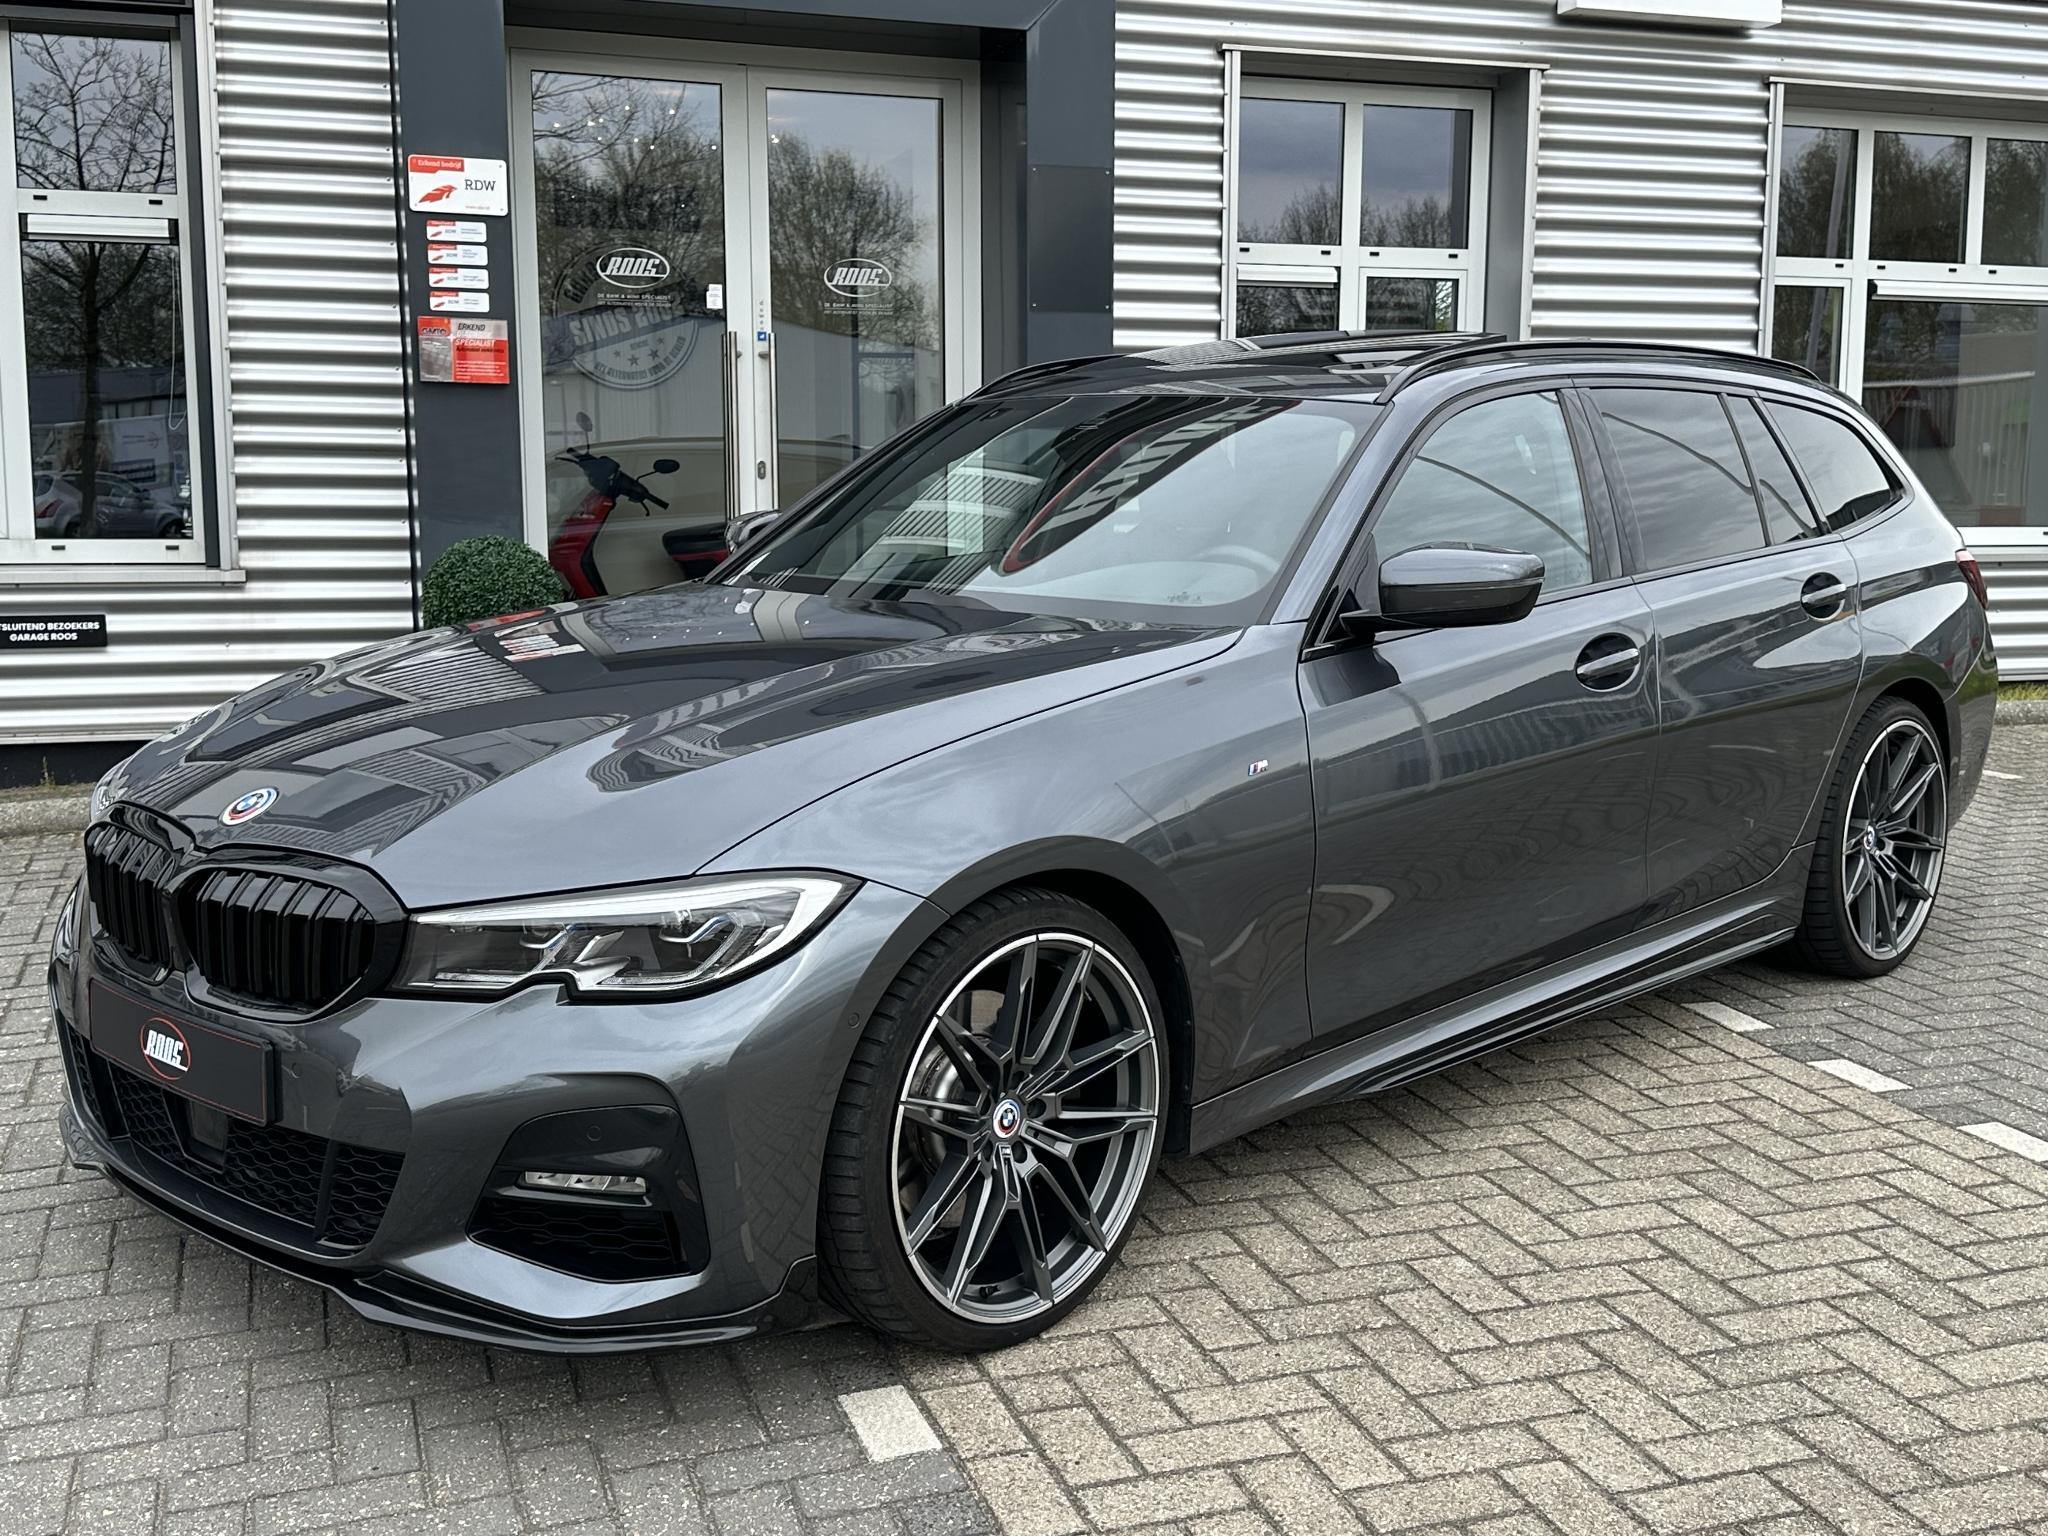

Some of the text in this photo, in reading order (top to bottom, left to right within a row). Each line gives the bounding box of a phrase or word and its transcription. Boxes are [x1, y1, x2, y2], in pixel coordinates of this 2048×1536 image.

[464, 178, 497, 192] RDW
[605, 256, 660, 276] ROOS
[832, 267, 882, 286] ROOS
[457, 322, 486, 332] ERKEND
[569, 307, 632, 347] SINDS
[454, 338, 496, 347] SPECIALIST
[47, 622, 100, 631] BEZOEKERS
[9, 632, 78, 641] GARAGE ROOS
[146, 1029, 184, 1067] ROOS
